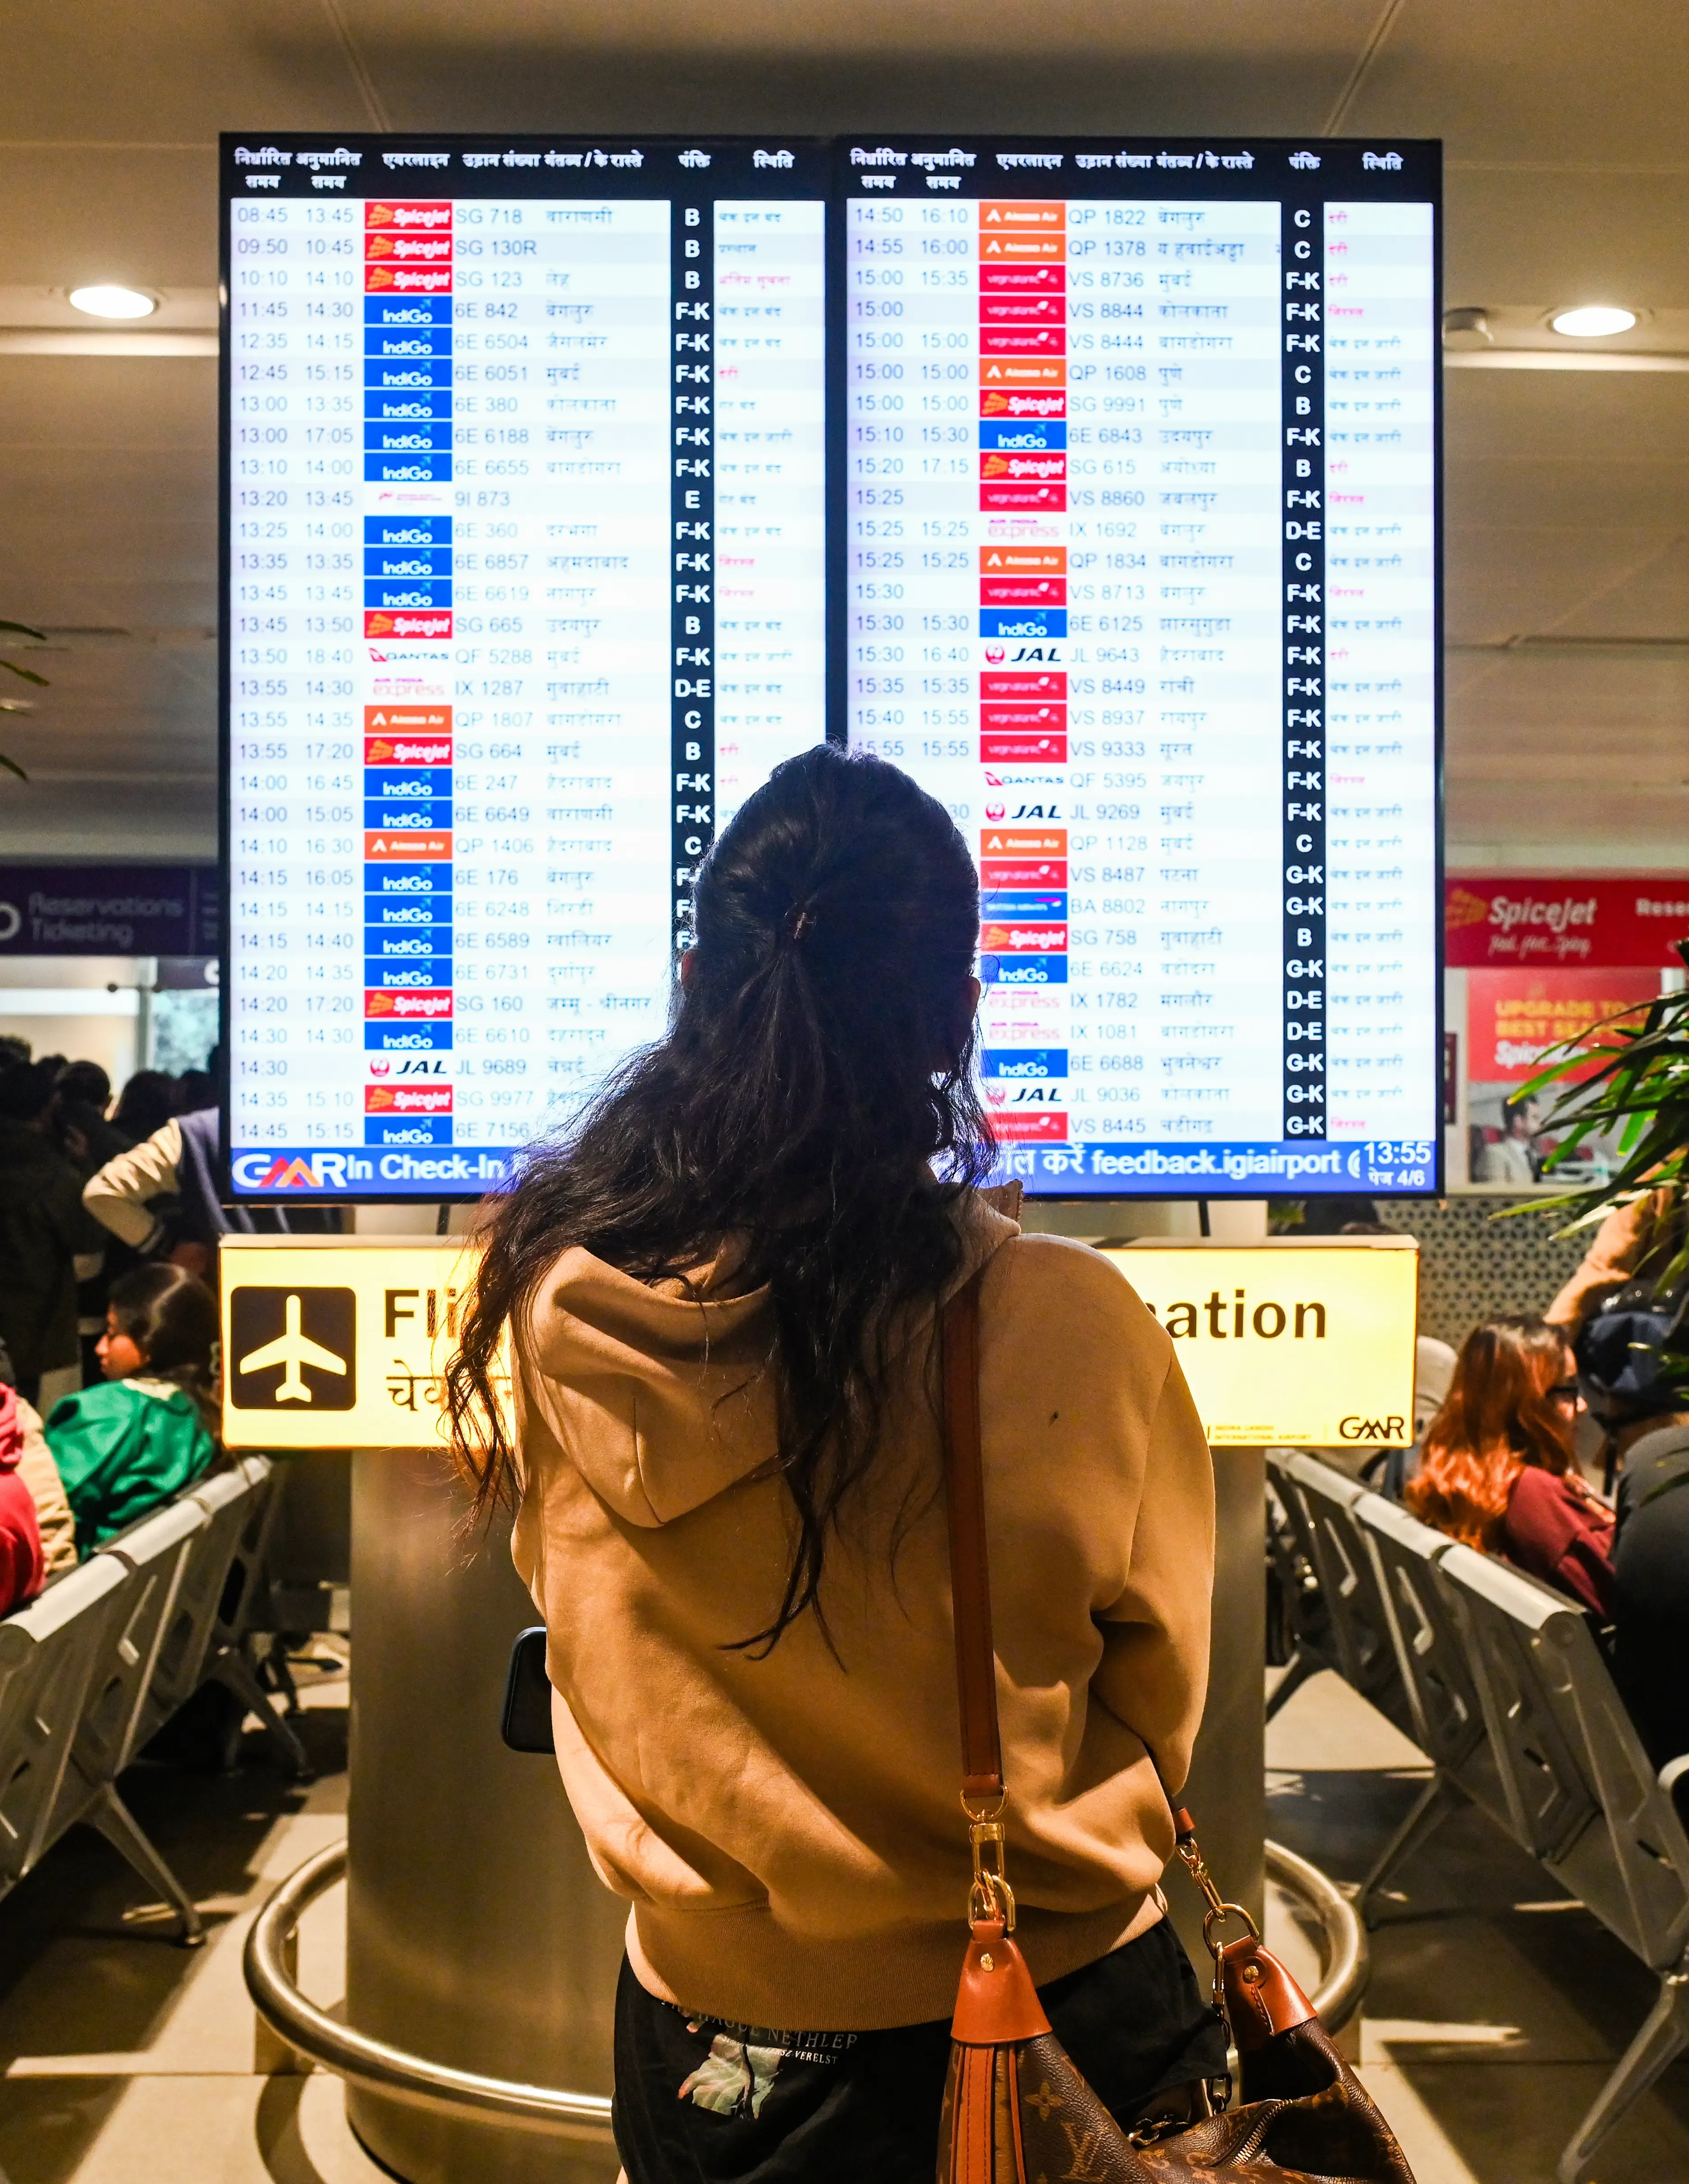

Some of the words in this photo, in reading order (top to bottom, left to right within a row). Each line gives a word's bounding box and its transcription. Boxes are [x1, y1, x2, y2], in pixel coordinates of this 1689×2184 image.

[856, 207, 903, 222] 14:50
[922, 208, 968, 223] 16:10
[1069, 209, 1096, 224] QP
[1105, 209, 1145, 226] 1822
[1295, 210, 1310, 227] C
[237, 238, 288, 254] 09:50
[307, 239, 353, 254] 10:45
[456, 239, 484, 256] SG
[493, 239, 536, 256] 130R
[685, 240, 700, 257] B
[241, 302, 288, 316] 11:45
[307, 302, 353, 317] 14:30
[383, 309, 432, 323] IndiGo
[455, 302, 477, 318] 6E
[485, 302, 518, 318] 842
[676, 302, 709, 320] F-K
[856, 300, 903, 317] 15:00
[1069, 302, 1094, 318] VS
[1101, 303, 1143, 318] 8844
[1287, 303, 1320, 321] F-K
[240, 365, 287, 380] 12:45
[306, 365, 353, 380] 15:15
[383, 372, 432, 386] IndiGo
[455, 365, 477, 381] 6E
[485, 365, 527, 381] 6051
[676, 365, 710, 383] F-K
[856, 363, 904, 379] 15:00
[922, 364, 969, 380] 15:00
[1069, 365, 1096, 381] QP
[1106, 366, 1146, 381] 1608
[1295, 366, 1311, 383] C
[856, 426, 904, 442] 15:10
[922, 426, 969, 442] 15:30
[998, 434, 1046, 448] IndiGo
[1069, 428, 1090, 443] 6E
[1098, 428, 1142, 443] 6843
[1287, 428, 1320, 446] F-K
[240, 490, 288, 506] 13:20
[306, 491, 353, 506] 13:45
[477, 491, 510, 506] 873
[685, 491, 700, 508] E
[240, 553, 287, 569] 13:35
[306, 553, 353, 569] 13:35
[383, 560, 432, 574] IndiGo
[455, 554, 477, 570] 6E
[485, 554, 529, 570] 6857
[676, 553, 710, 571] F-K
[240, 680, 287, 696] 13:55
[306, 681, 353, 695] 14:30
[455, 680, 473, 696] IX
[482, 680, 523, 696] 1287
[675, 679, 711, 697] D-E
[857, 677, 904, 693] 15:35
[923, 678, 969, 694] 15:35
[1070, 678, 1096, 694] VS
[1102, 679, 1145, 694] 8449
[1288, 678, 1321, 696] F-K
[240, 743, 288, 759] 13:55
[306, 743, 354, 759] 17:20
[456, 743, 484, 759] SG
[490, 744, 522, 758] 664
[686, 742, 700, 760] B
[923, 740, 969, 756] 15:55
[1070, 741, 1095, 757] VS
[1102, 741, 1145, 757] 9333
[1288, 740, 1321, 758] F-K
[1070, 773, 1096, 789] QF
[1103, 772, 1147, 788] 5395
[1288, 772, 1321, 790] F-K
[1012, 806, 1060, 818] JAL
[1070, 804, 1090, 820] JL
[1096, 804, 1140, 820] 9269
[240, 933, 287, 948] 14:15
[307, 934, 353, 947] 14:40
[383, 939, 432, 953] IndiGo
[455, 933, 477, 948] 6E
[485, 933, 530, 948] 6589
[1071, 930, 1098, 945] SG
[1106, 930, 1137, 945] 758
[1298, 929, 1311, 946] B
[241, 997, 288, 1012] 14:20
[306, 996, 354, 1012] 17:20
[456, 996, 484, 1012] SG
[493, 996, 523, 1011] 160
[241, 1060, 287, 1075] 14:30
[396, 1061, 446, 1074] JAL
[456, 1060, 475, 1075] JL
[482, 1059, 527, 1074] 9689
[999, 1062, 1048, 1076] IndiGo
[1070, 1056, 1092, 1071] 6E
[1100, 1056, 1144, 1071] 6688
[1287, 1054, 1324, 1071] G-K
[1041, 1142, 1086, 1174] करें
[1092, 1149, 1342, 1181] feedback.igiairport
[1363, 1142, 1432, 1165] 13:55
[1368, 1166, 1395, 1187] पेज
[1396, 1169, 1426, 1187] 4/6
[1145, 1288, 1327, 1339] ation
[794, 2050, 839, 2065] VERELST
